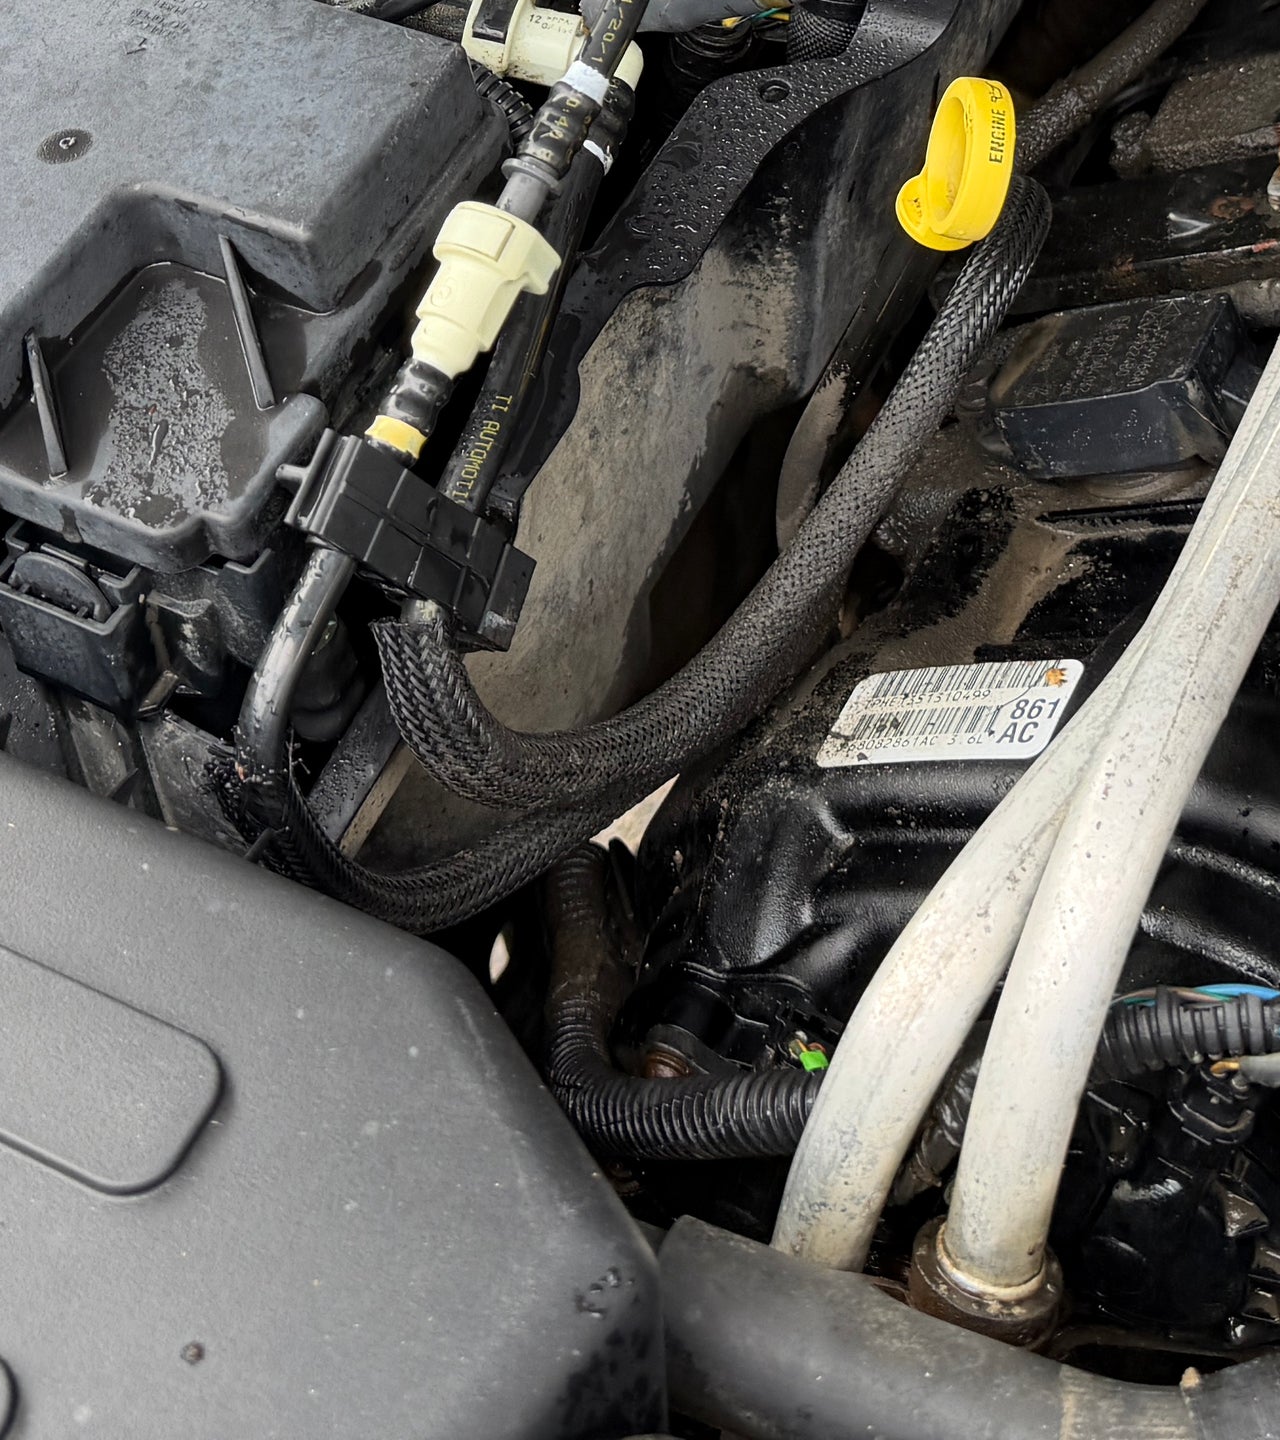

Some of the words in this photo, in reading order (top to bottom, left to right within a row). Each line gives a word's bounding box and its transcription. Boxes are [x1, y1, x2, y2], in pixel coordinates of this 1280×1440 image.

[989, 110, 1006, 164] ENGINE
[491, 395, 513, 412] TI
[1009, 698, 1060, 720] 861
[995, 721, 1039, 744] AC
